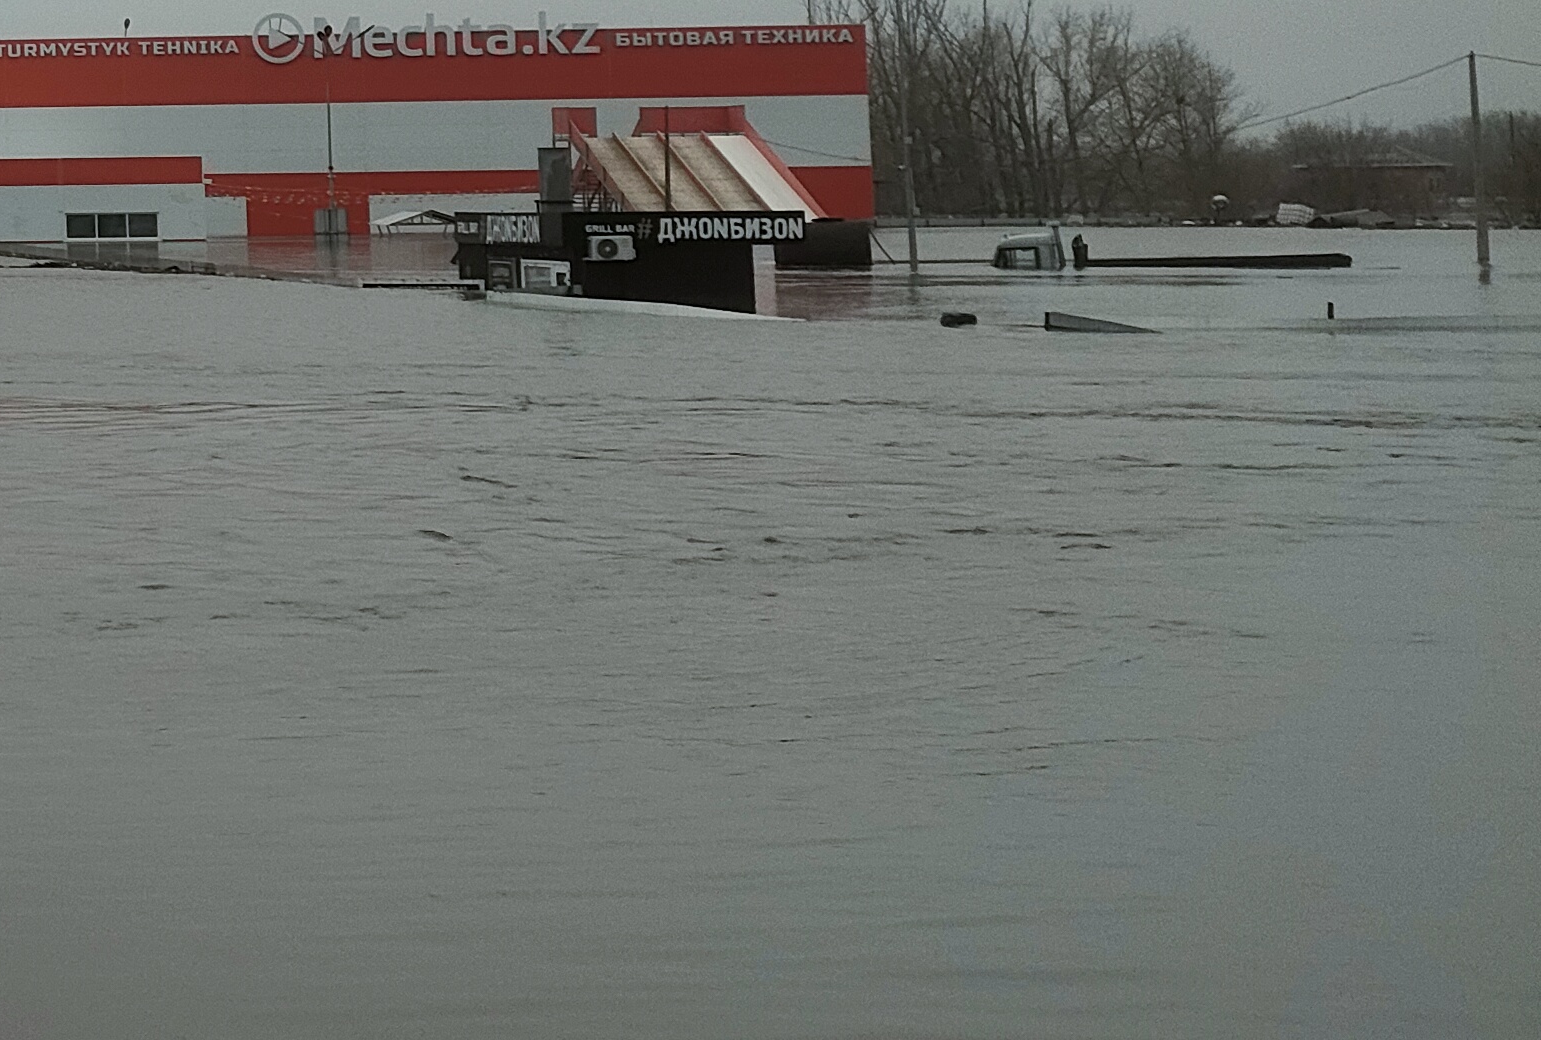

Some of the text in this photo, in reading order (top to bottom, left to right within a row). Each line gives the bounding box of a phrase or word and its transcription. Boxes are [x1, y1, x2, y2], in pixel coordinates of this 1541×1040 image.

[313, 11, 601, 59] Mechta.kz
[615, 29, 854, 47] БЫТОВАЯ ТЕХНИКА
[138, 40, 240, 56] TEHNIKA
[585, 225, 613, 233] GRILL
[615, 224, 635, 233] BAR
